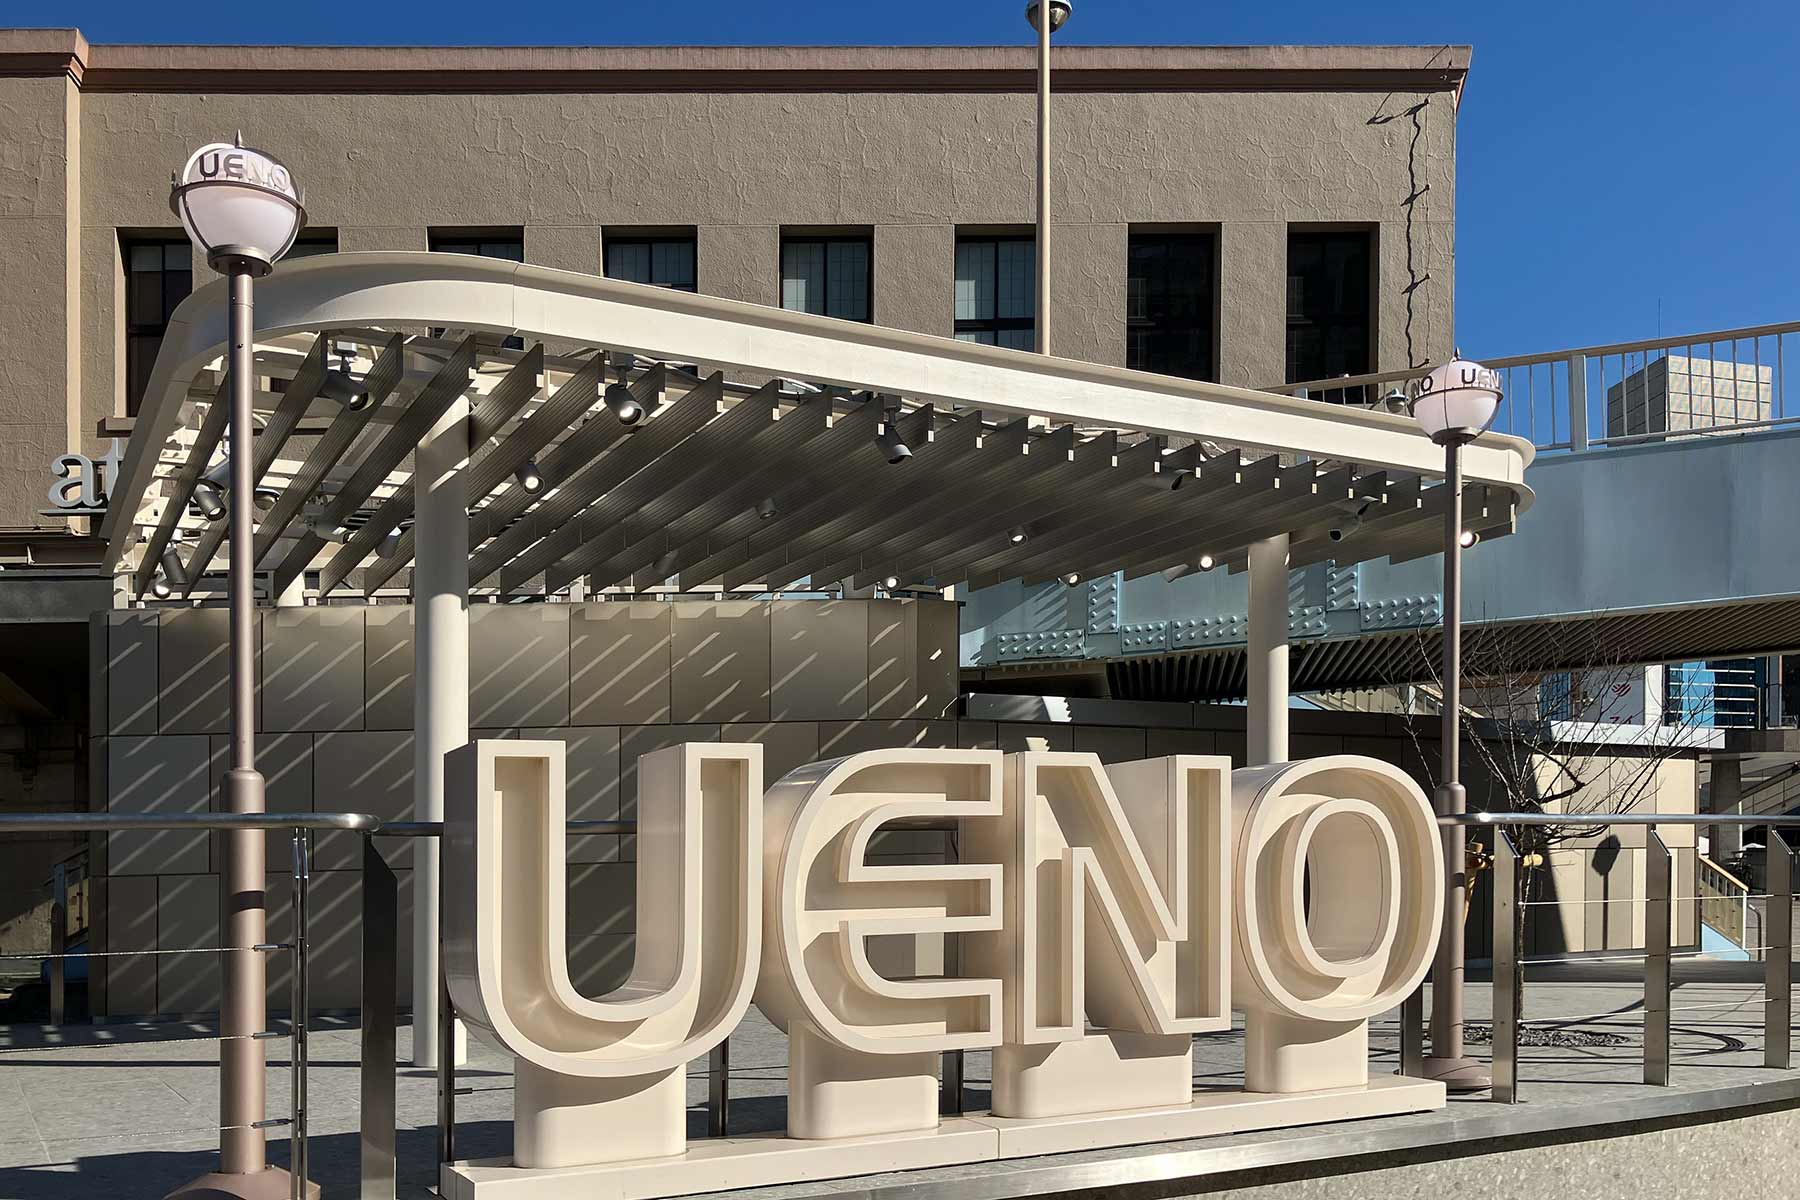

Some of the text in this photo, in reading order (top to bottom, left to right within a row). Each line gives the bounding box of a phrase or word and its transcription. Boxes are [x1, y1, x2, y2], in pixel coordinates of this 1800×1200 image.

[199, 152, 291, 192] UENO
[1461, 367, 1502, 388] UEN
[444, 739, 1446, 1079] UENO
